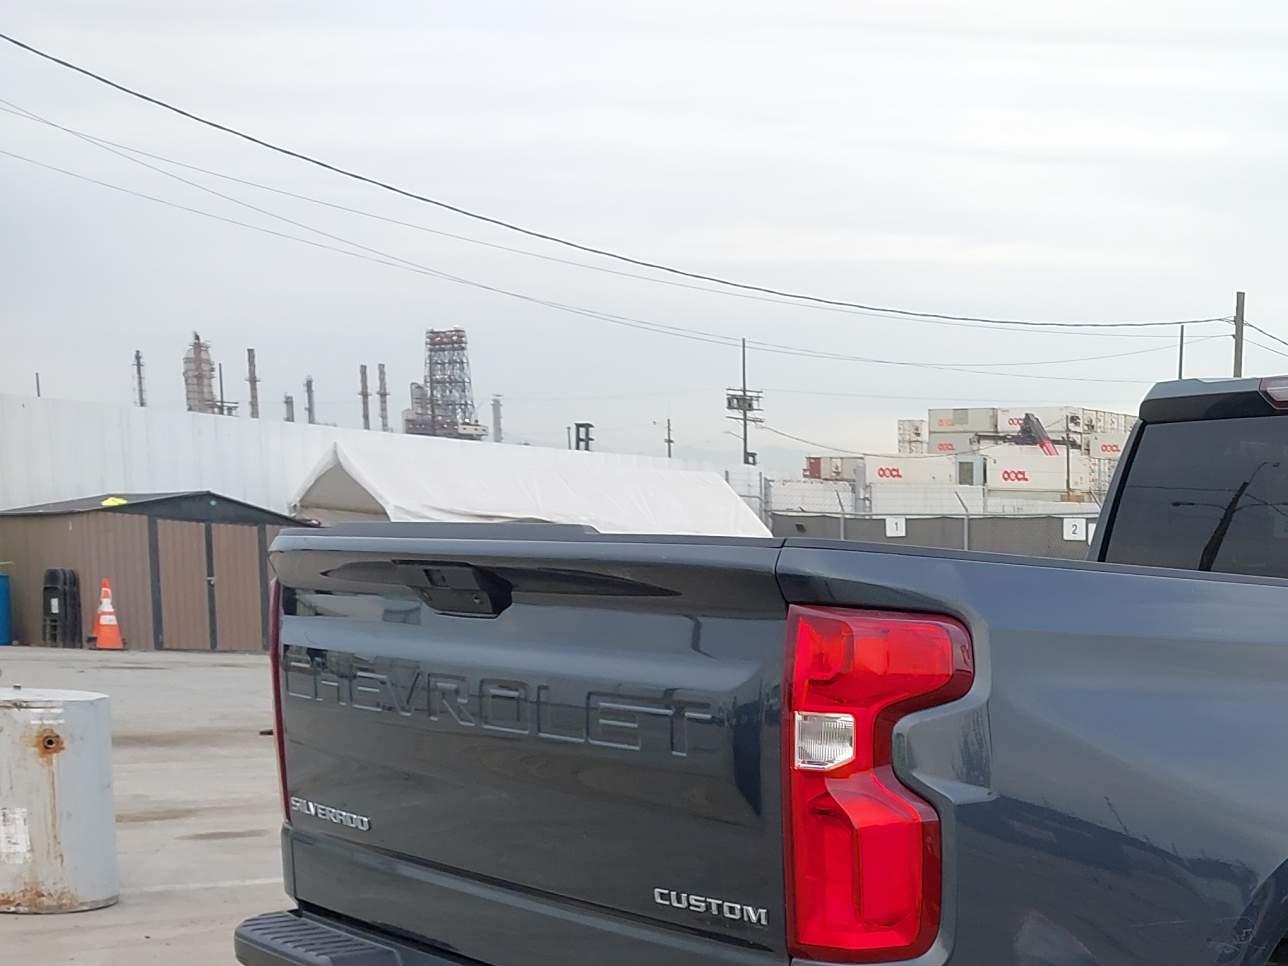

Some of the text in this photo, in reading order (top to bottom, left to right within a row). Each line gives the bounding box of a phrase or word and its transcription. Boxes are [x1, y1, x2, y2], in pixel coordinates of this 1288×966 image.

[878, 467, 903, 479] OOCL
[1002, 470, 1029, 481] OOCL
[894, 521, 899, 532] 1
[1071, 523, 1079, 535] 2
[284, 650, 714, 758] CHEVROLET
[290, 796, 370, 831] SILVERADO
[653, 887, 769, 926] CUSTOM
